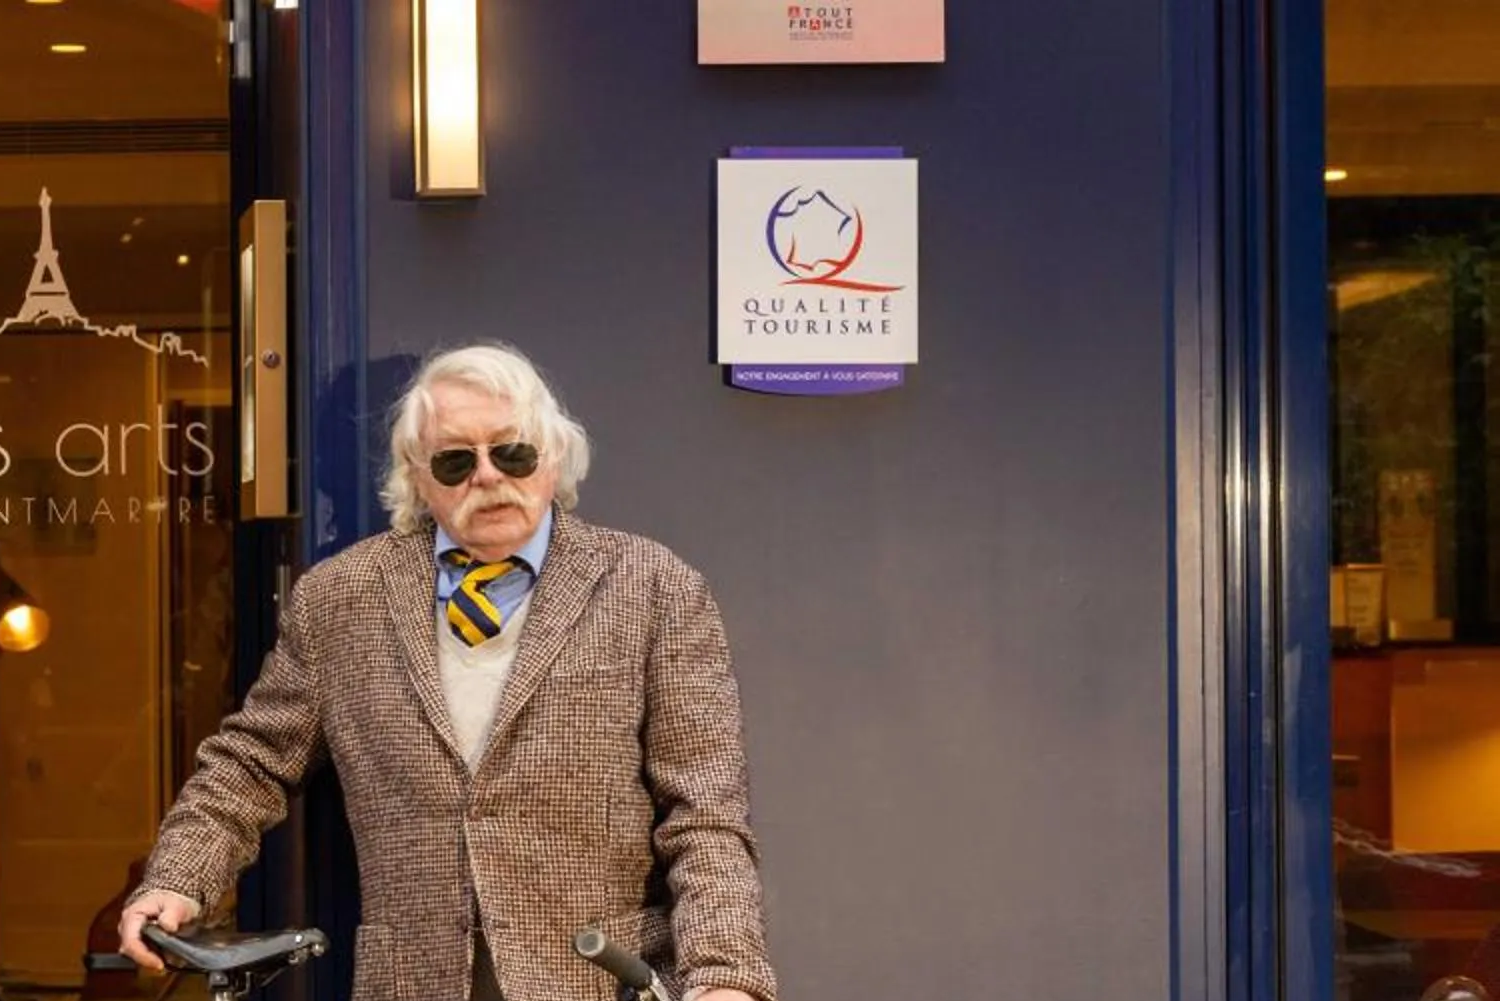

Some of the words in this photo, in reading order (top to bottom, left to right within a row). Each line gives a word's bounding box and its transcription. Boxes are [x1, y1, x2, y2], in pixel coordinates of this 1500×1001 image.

[789, 18, 853, 30] FRANCE
[743, 296, 892, 316] QUALITÉ
[744, 319, 892, 335] TOURISME
[55, 401, 215, 480] arts
